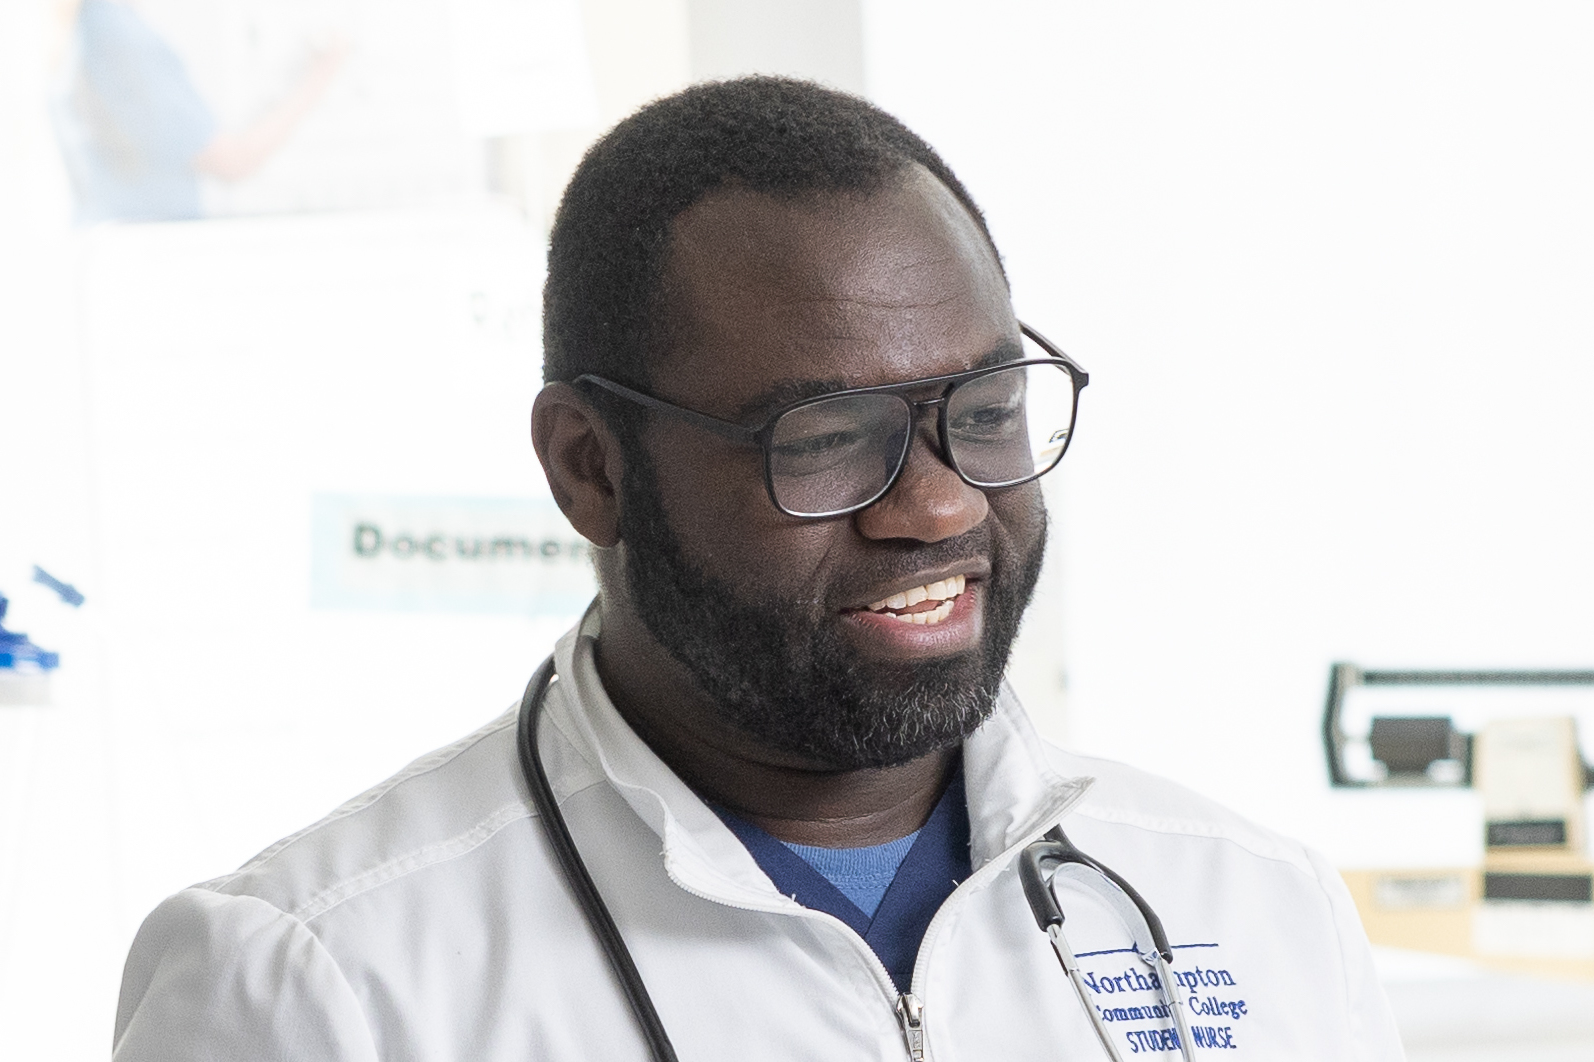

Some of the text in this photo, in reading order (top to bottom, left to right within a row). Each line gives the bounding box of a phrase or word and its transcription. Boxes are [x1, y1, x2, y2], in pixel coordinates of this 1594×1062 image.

[1189, 996, 1248, 1020] College
[1126, 1026, 1237, 1053] STUDEN NURSE
